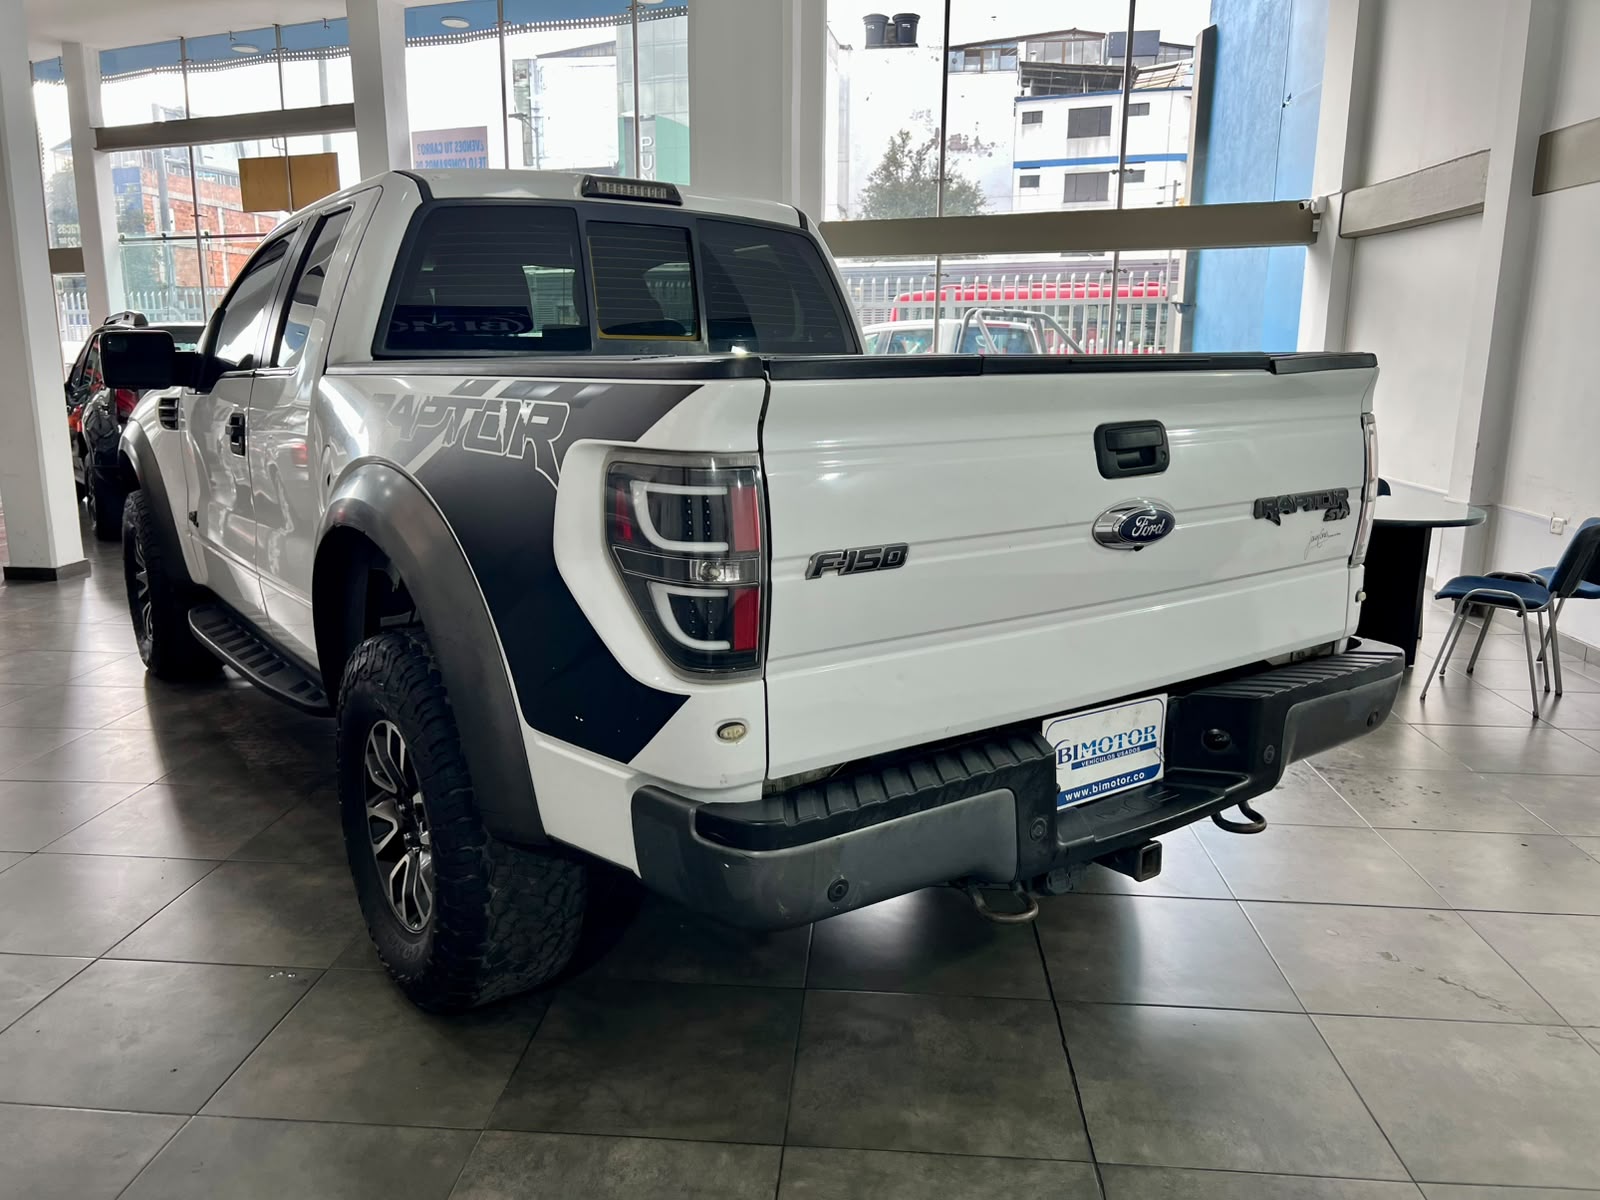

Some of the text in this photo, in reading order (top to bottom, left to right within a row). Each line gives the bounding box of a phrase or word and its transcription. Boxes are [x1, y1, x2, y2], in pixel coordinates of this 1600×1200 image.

[360, 392, 572, 486] RAPTOR
[1254, 487, 1350, 526] RAPTOR
[1131, 515, 1166, 537] Ford
[805, 542, 909, 580] F-150
[1057, 725, 1157, 765] BIMOTOR
[1117, 746, 1141, 758] USADOS
[1065, 771, 1145, 801] www.bimotor.co
